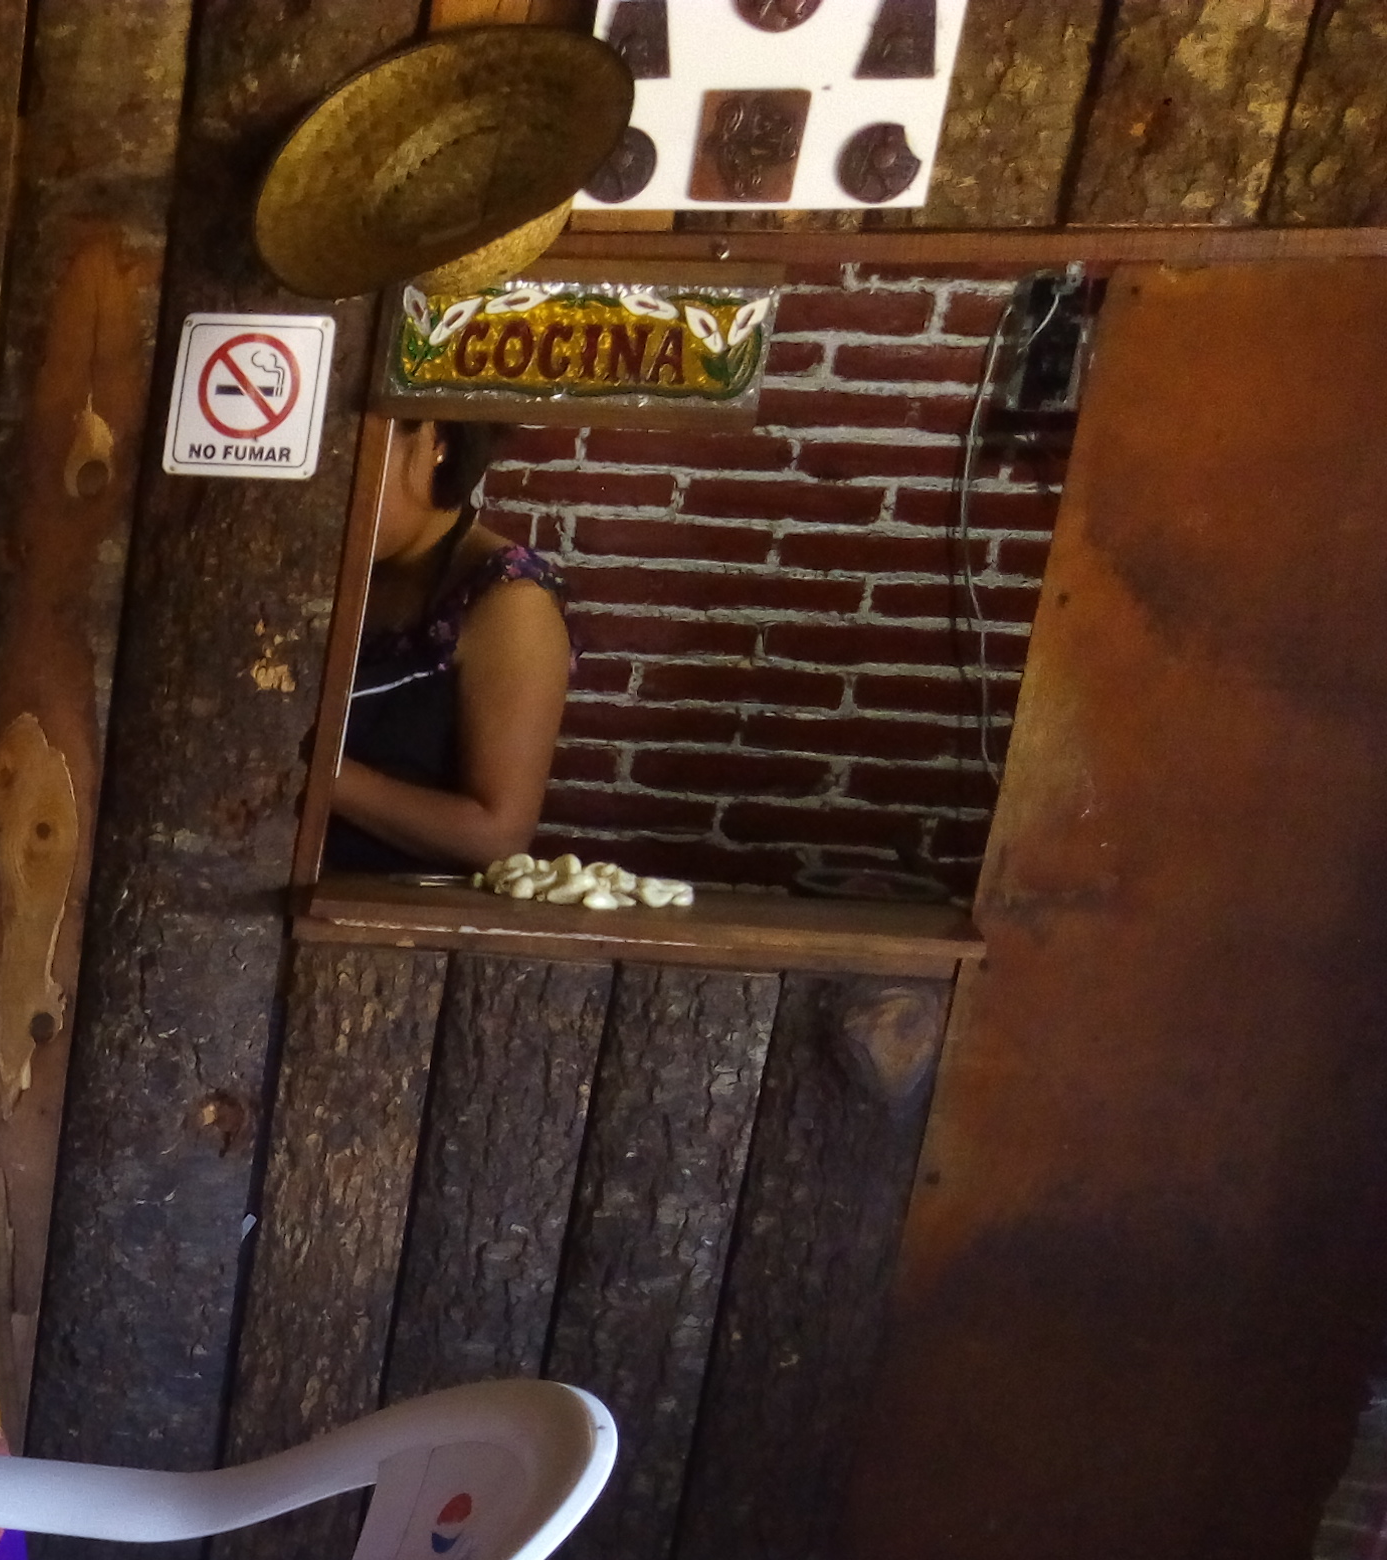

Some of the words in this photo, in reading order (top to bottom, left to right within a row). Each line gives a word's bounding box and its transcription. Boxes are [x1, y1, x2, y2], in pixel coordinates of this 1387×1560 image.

[454, 317, 685, 385] COCINA
[188, 443, 216, 460] NO
[222, 444, 291, 463] FUMAR
